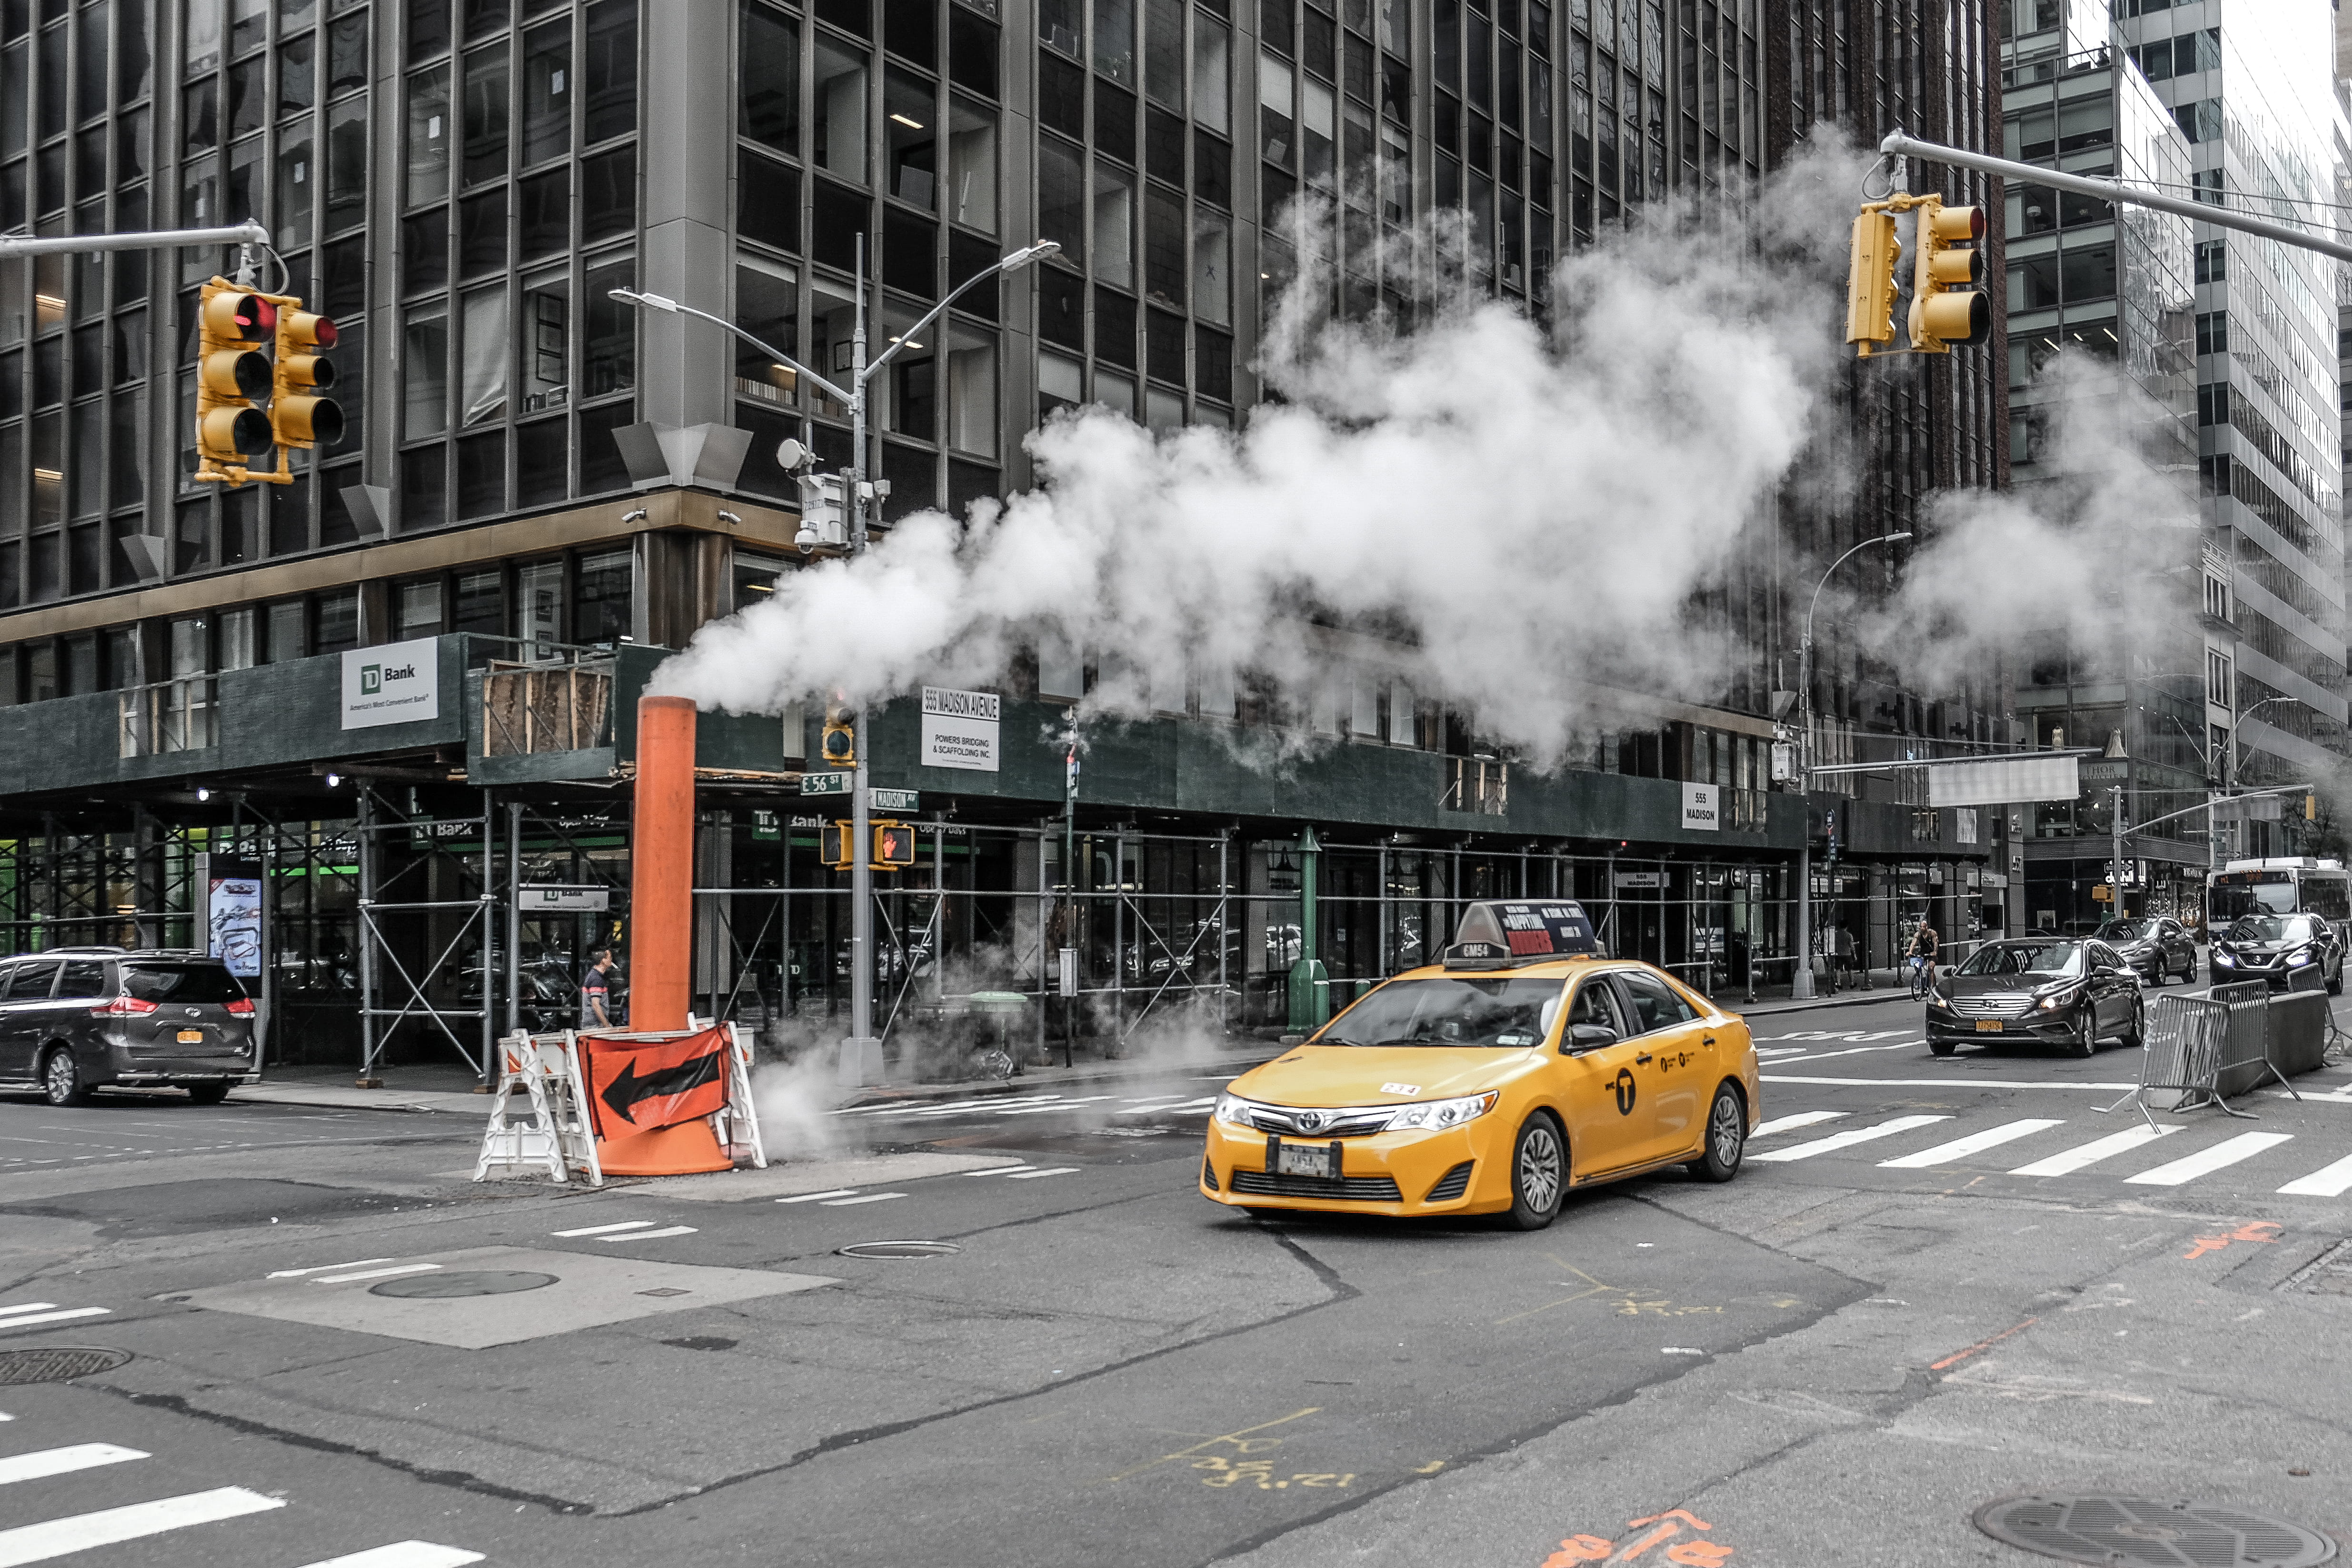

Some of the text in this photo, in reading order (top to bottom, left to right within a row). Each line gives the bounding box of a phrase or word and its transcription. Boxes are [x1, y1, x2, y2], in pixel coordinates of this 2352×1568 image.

[362, 663, 416, 690] TD Bank
[925, 689, 997, 718] 555 MADISON AVENUE
[935, 734, 989, 748] POWERS BRIDGING
[933, 745, 937, 753] &
[938, 745, 978, 758] SCAFFOLDING
[802, 777, 809, 792] E
[812, 776, 827, 792] 56
[877, 791, 916, 808] MADISON AV
[1695, 792, 1706, 804] 555
[1686, 808, 1715, 820] MADISON
